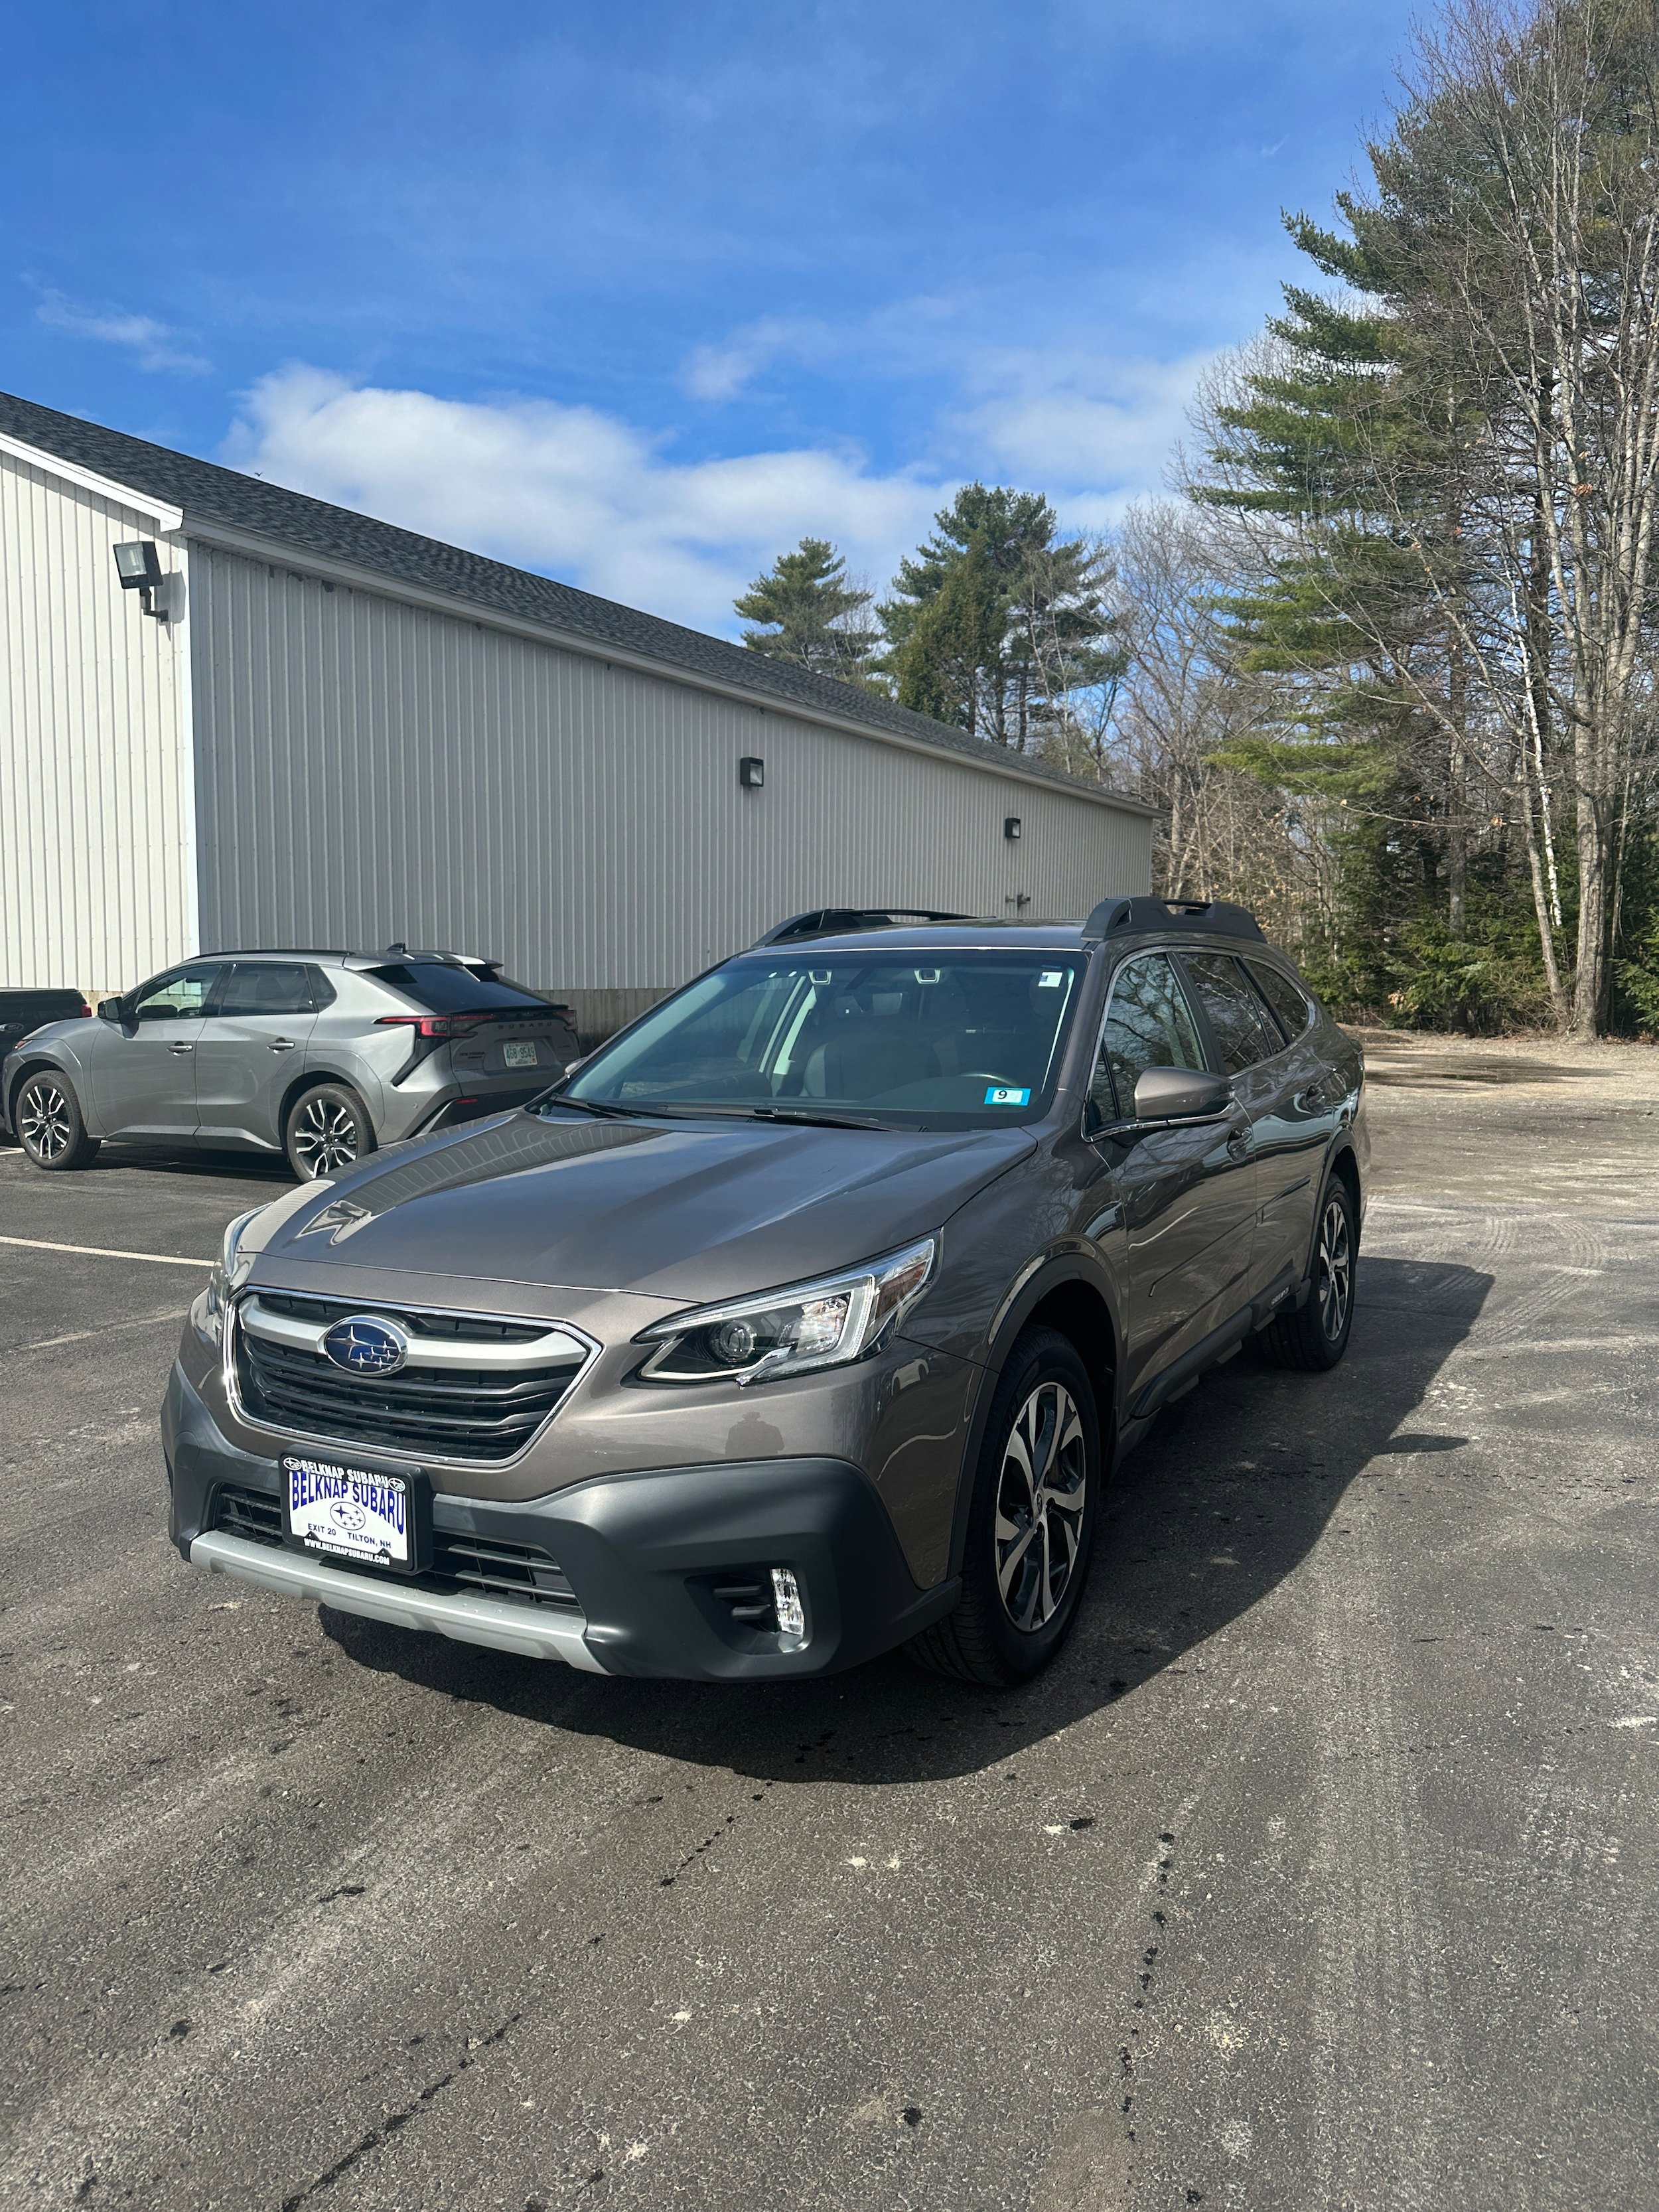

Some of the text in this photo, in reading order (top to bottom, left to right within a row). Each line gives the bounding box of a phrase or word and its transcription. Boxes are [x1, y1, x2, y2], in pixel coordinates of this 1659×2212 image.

[998, 1090, 1007, 1100] 9
[301, 1460, 390, 1489] BELKNAP SUBARU
[292, 1471, 404, 1534] BELKNAP SUBARU
[308, 1523, 325, 1533] EXIT
[347, 1532, 378, 1547] TILTON,
[380, 1539, 392, 1549] NH
[303, 1538, 390, 1566] WWW.BELKNAPSUBARU.COM
